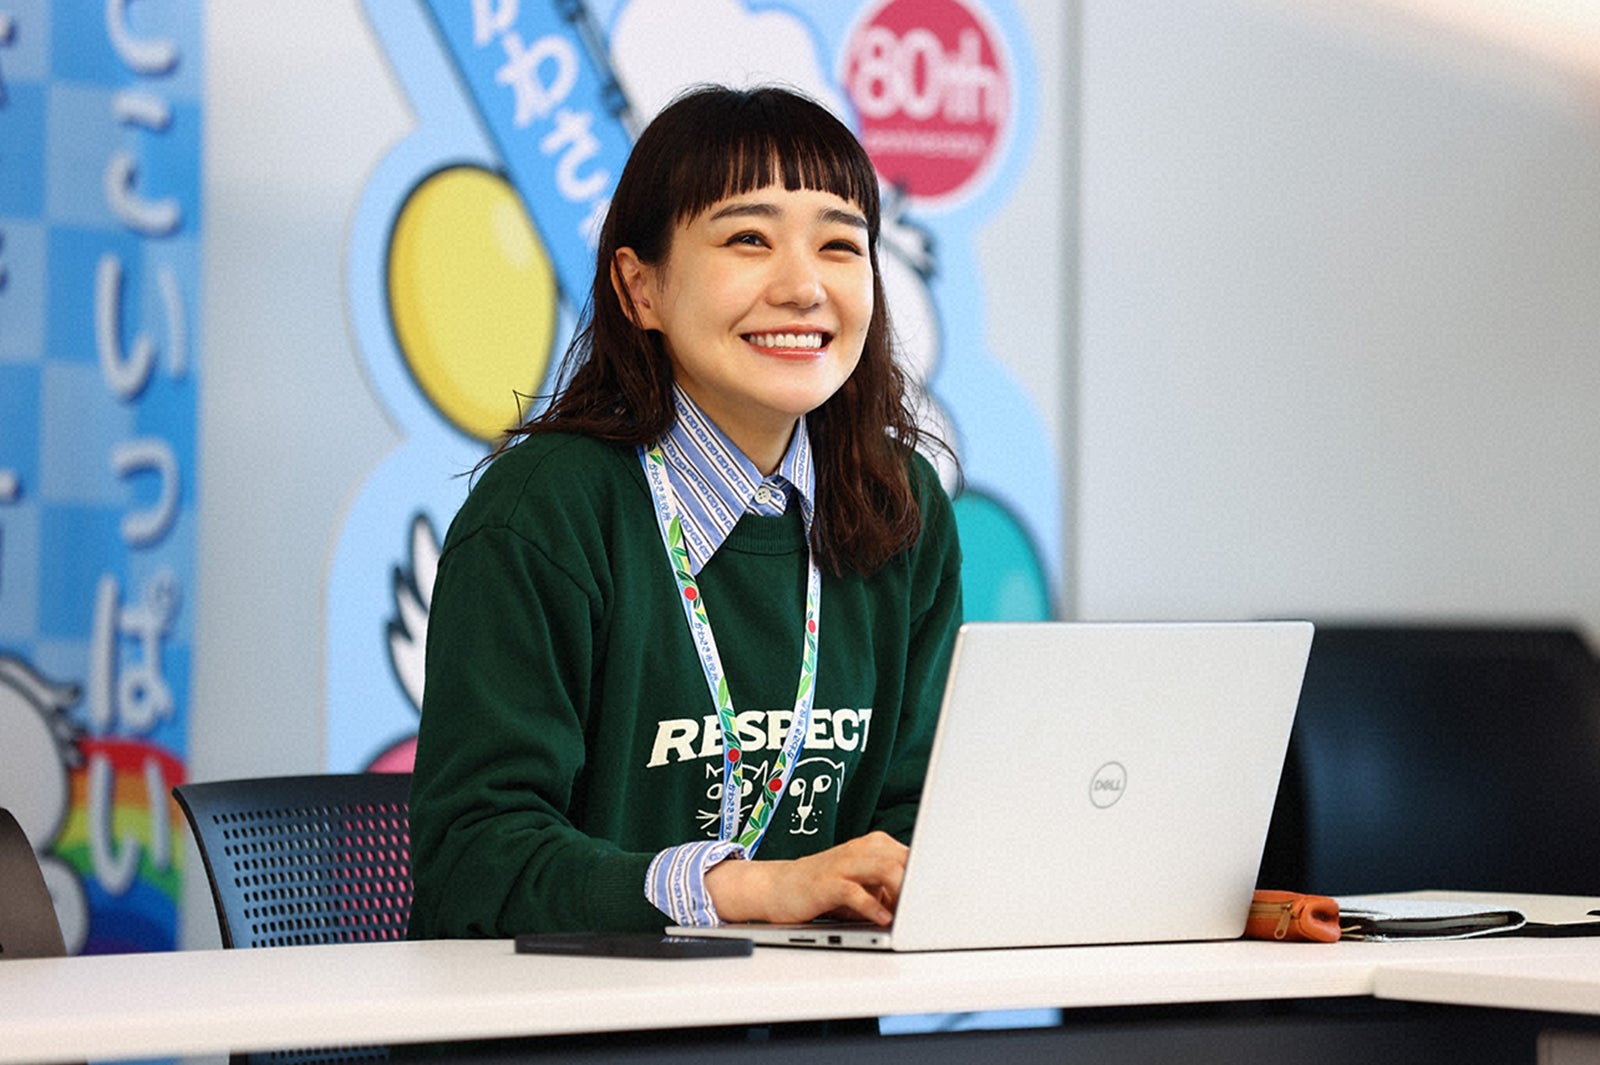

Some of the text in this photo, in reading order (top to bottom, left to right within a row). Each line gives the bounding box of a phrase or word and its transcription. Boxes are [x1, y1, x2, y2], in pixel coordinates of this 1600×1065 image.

[648, 463, 671, 521] かわさき市役所
[694, 622, 719, 681] かわさき市役所
[1094, 779, 1121, 791] DELL
